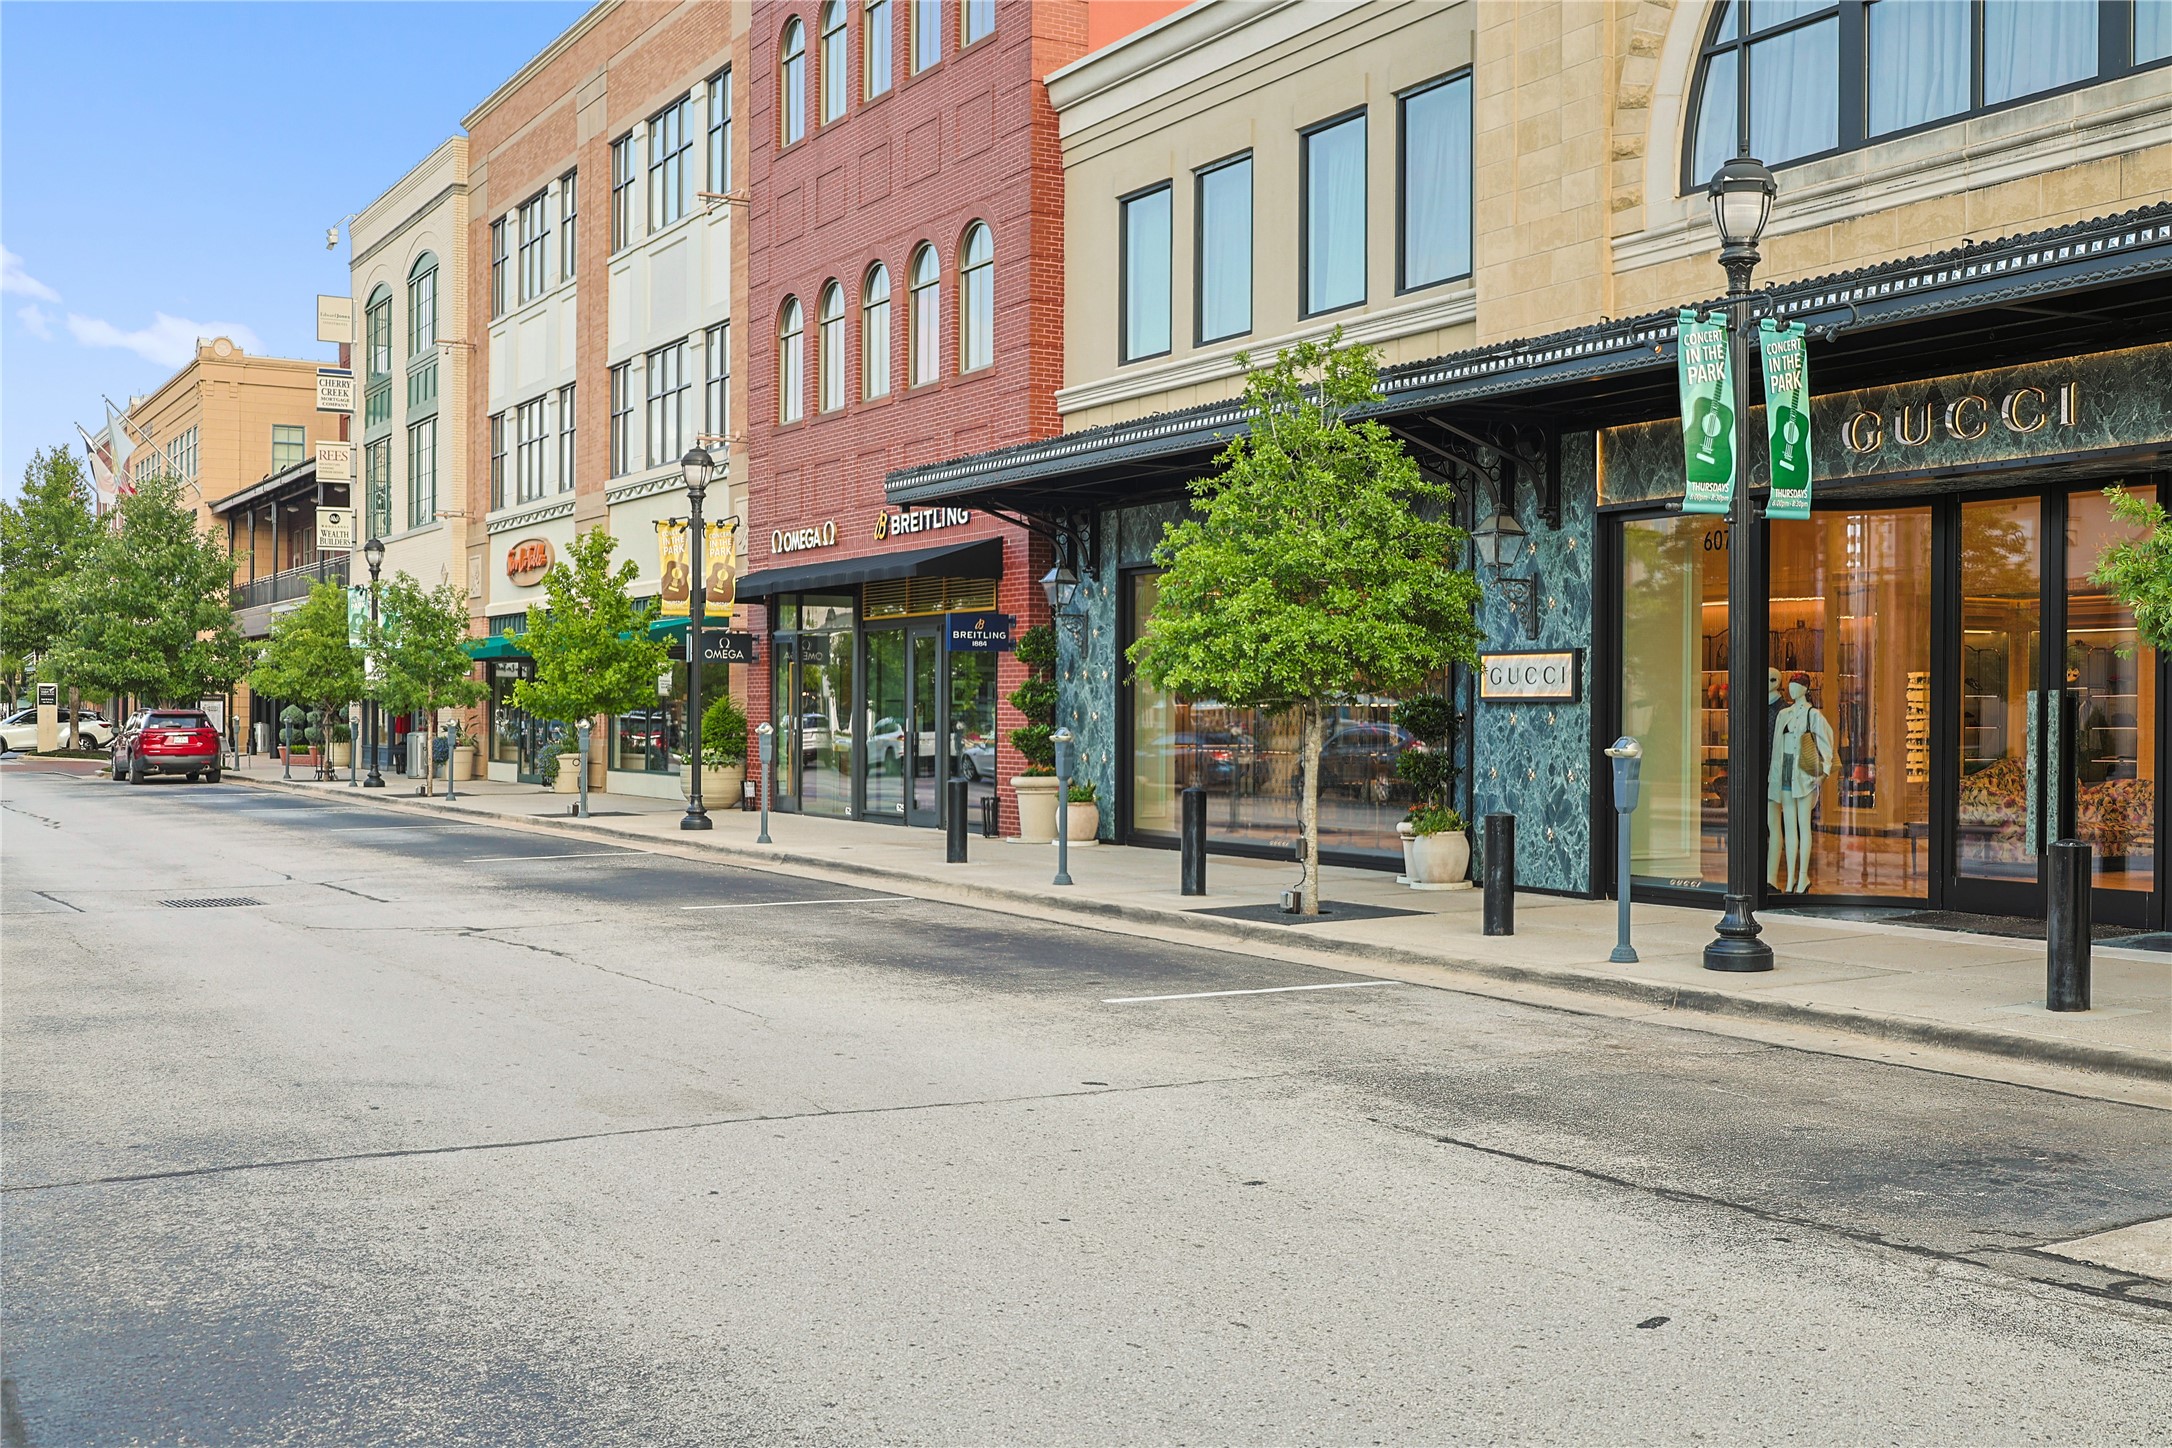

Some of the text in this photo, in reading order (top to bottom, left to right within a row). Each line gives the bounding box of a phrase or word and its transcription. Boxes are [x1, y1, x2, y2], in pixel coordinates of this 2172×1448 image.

[1683, 329, 1723, 346] CONCERT
[1766, 338, 1801, 356] CONCERT
[1685, 343, 1725, 364] IN THE
[1768, 352, 1801, 373] IN THE
[1687, 361, 1727, 385] PARK
[319, 378, 351, 388] CHERRY
[1770, 370, 1803, 394] PARK
[321, 388, 349, 397] CREEK
[1841, 381, 2077, 454] GUCCI
[319, 449, 349, 461] REES
[1691, 482, 1730, 493] THURSDAYS
[1775, 488, 1808, 499] THURSDAYS
[891, 507, 969, 536] BREITLING
[320, 529, 349, 538] WEALTH
[783, 526, 823, 552] OMEGA
[320, 537, 351, 546] BUILDERS
[662, 536, 685, 547] IN THE
[709, 538, 732, 548] IN THE
[663, 543, 685, 556] PARK
[709, 547, 732, 558] PARK
[952, 630, 1007, 640] BREITLING
[704, 649, 745, 659] OMEGA
[1490, 666, 1565, 685] GUCCI
[1669, 878, 1702, 888] GUCCI
